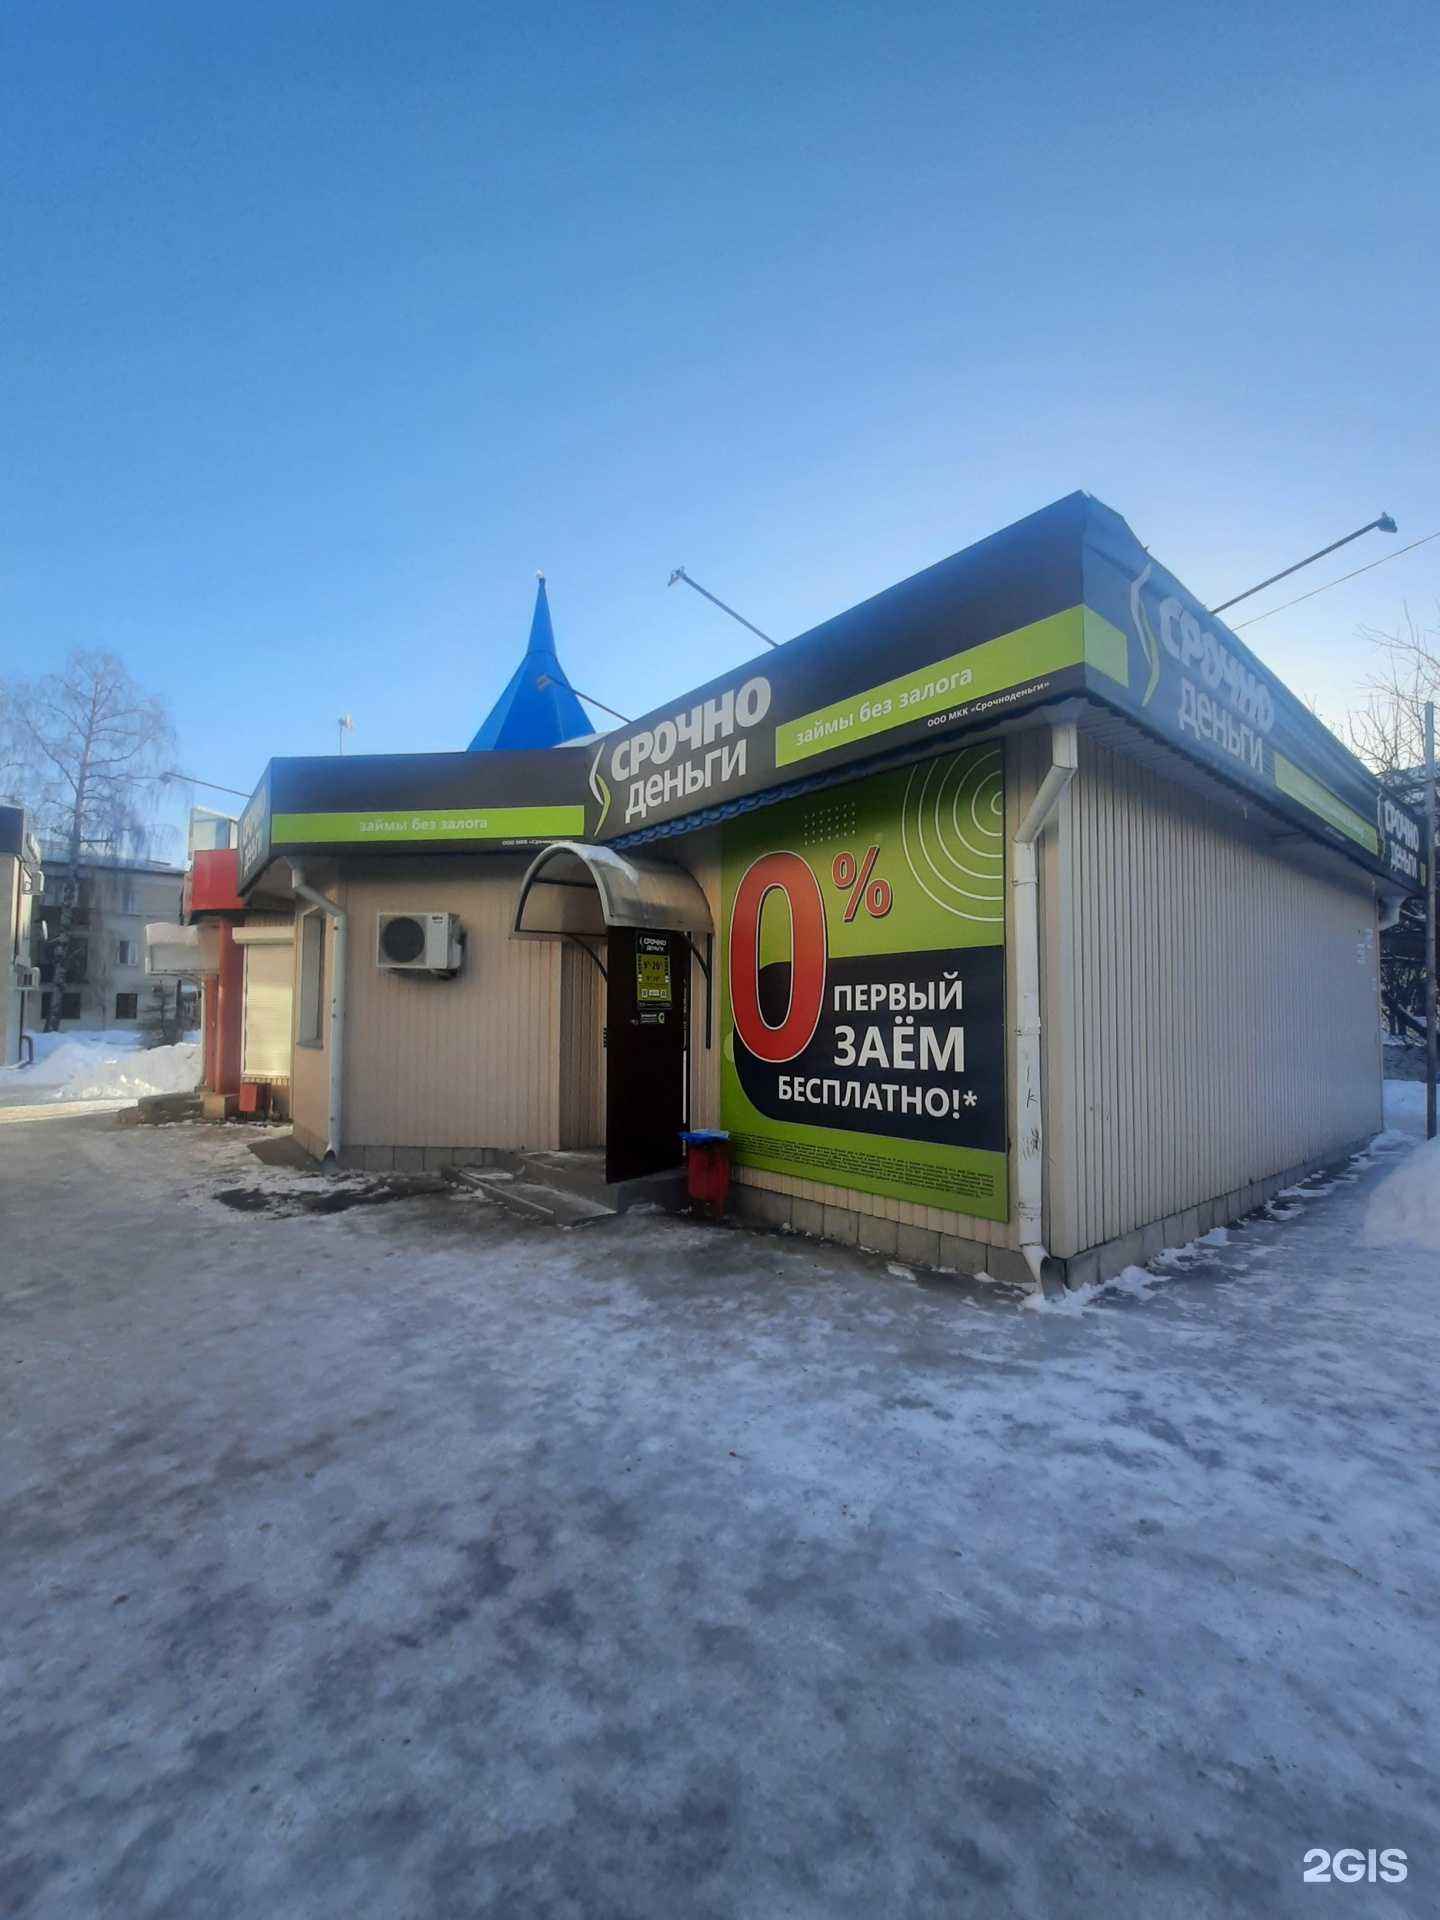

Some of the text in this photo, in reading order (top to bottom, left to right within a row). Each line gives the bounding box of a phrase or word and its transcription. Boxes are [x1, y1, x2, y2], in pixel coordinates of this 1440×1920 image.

[1160, 597, 1274, 734] СРОЧНО
[611, 676, 771, 782] СРОЧНО
[795, 667, 973, 746] займы без залога
[927, 714, 947, 727] ООО
[948, 707, 969, 721] МКК
[1178, 677, 1263, 774] деньги
[624, 738, 747, 824] деньги
[359, 818, 488, 832] займы без залога
[833, 971, 964, 1012] ПЕРВЫЙ
[833, 1016, 966, 1073] ЗАЁМ
